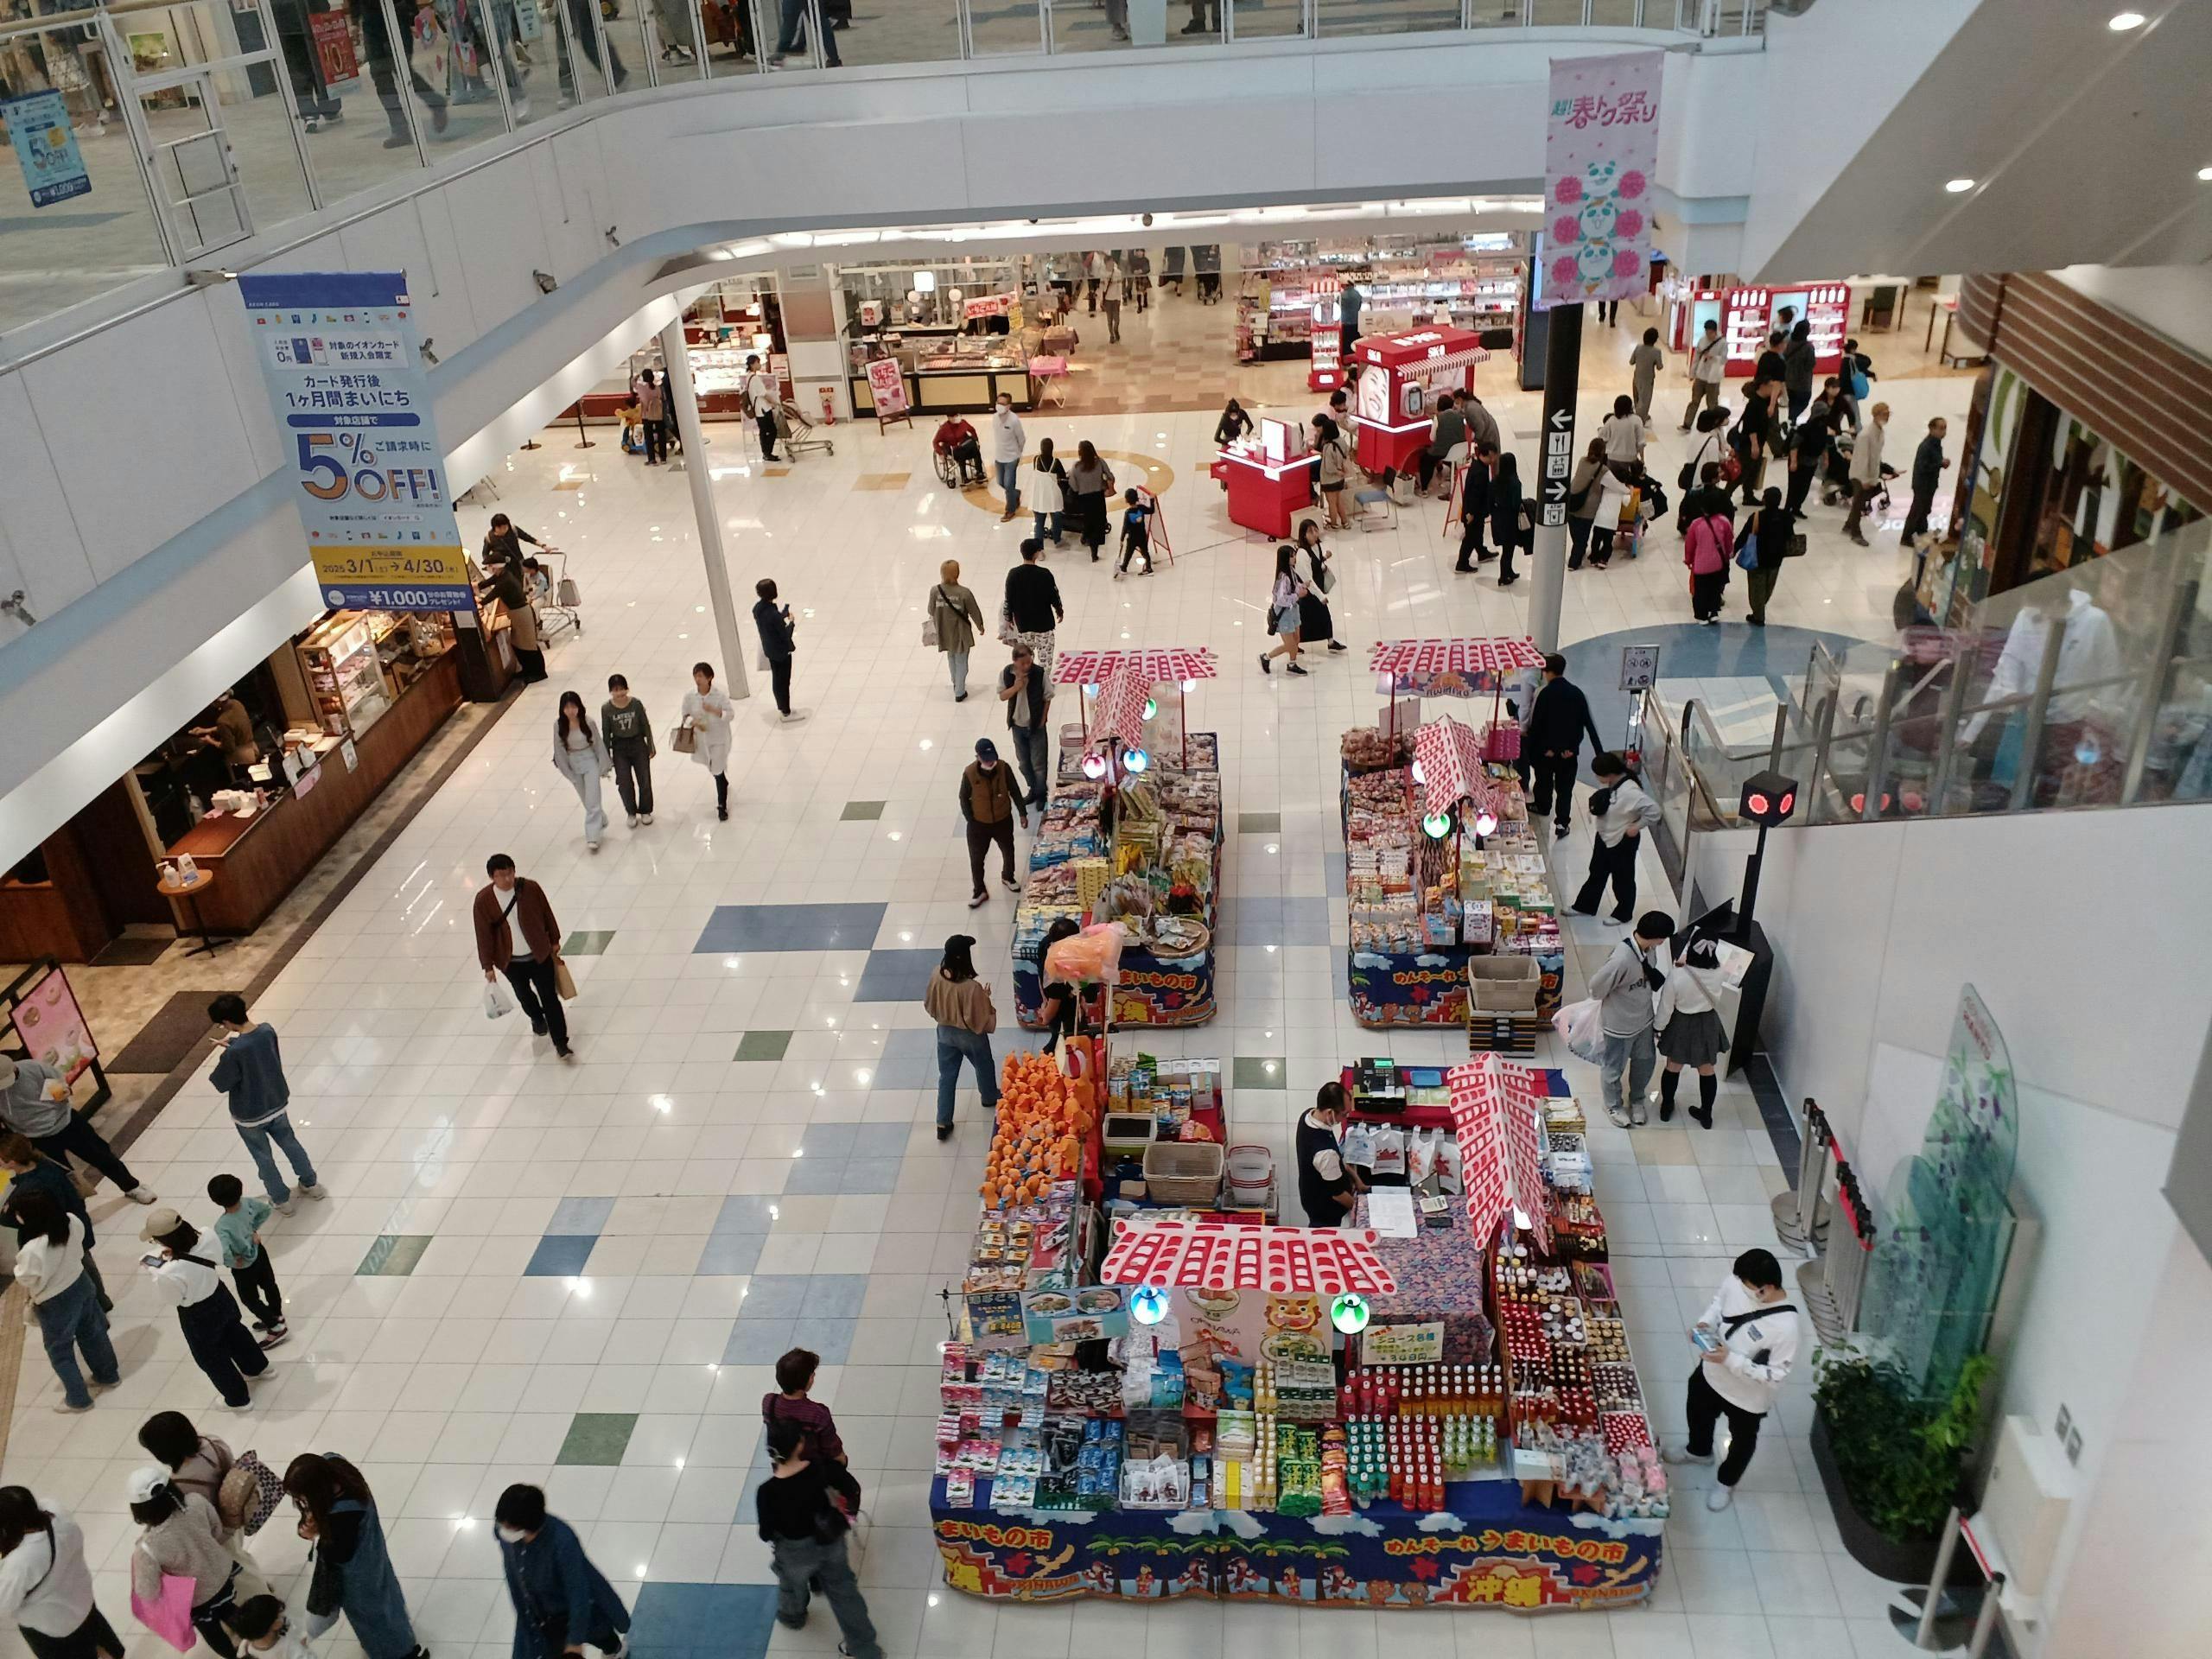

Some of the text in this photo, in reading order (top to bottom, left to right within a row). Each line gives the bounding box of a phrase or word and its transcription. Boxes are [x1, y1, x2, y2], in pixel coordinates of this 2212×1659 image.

[328, 340, 399, 351] 対象のイオンカード
[340, 351, 393, 360] 新規入会限定
[304, 374, 381, 388] カード発行後
[375, 441, 431, 452] ご請求時に
[353, 468, 440, 501] OFF!
[619, 718, 632, 730] 17
[936, 1519, 1052, 1549] まいもの市
[1479, 1529, 1629, 1563] うまいもの市
[1466, 1573, 1542, 1607] 沖縄
